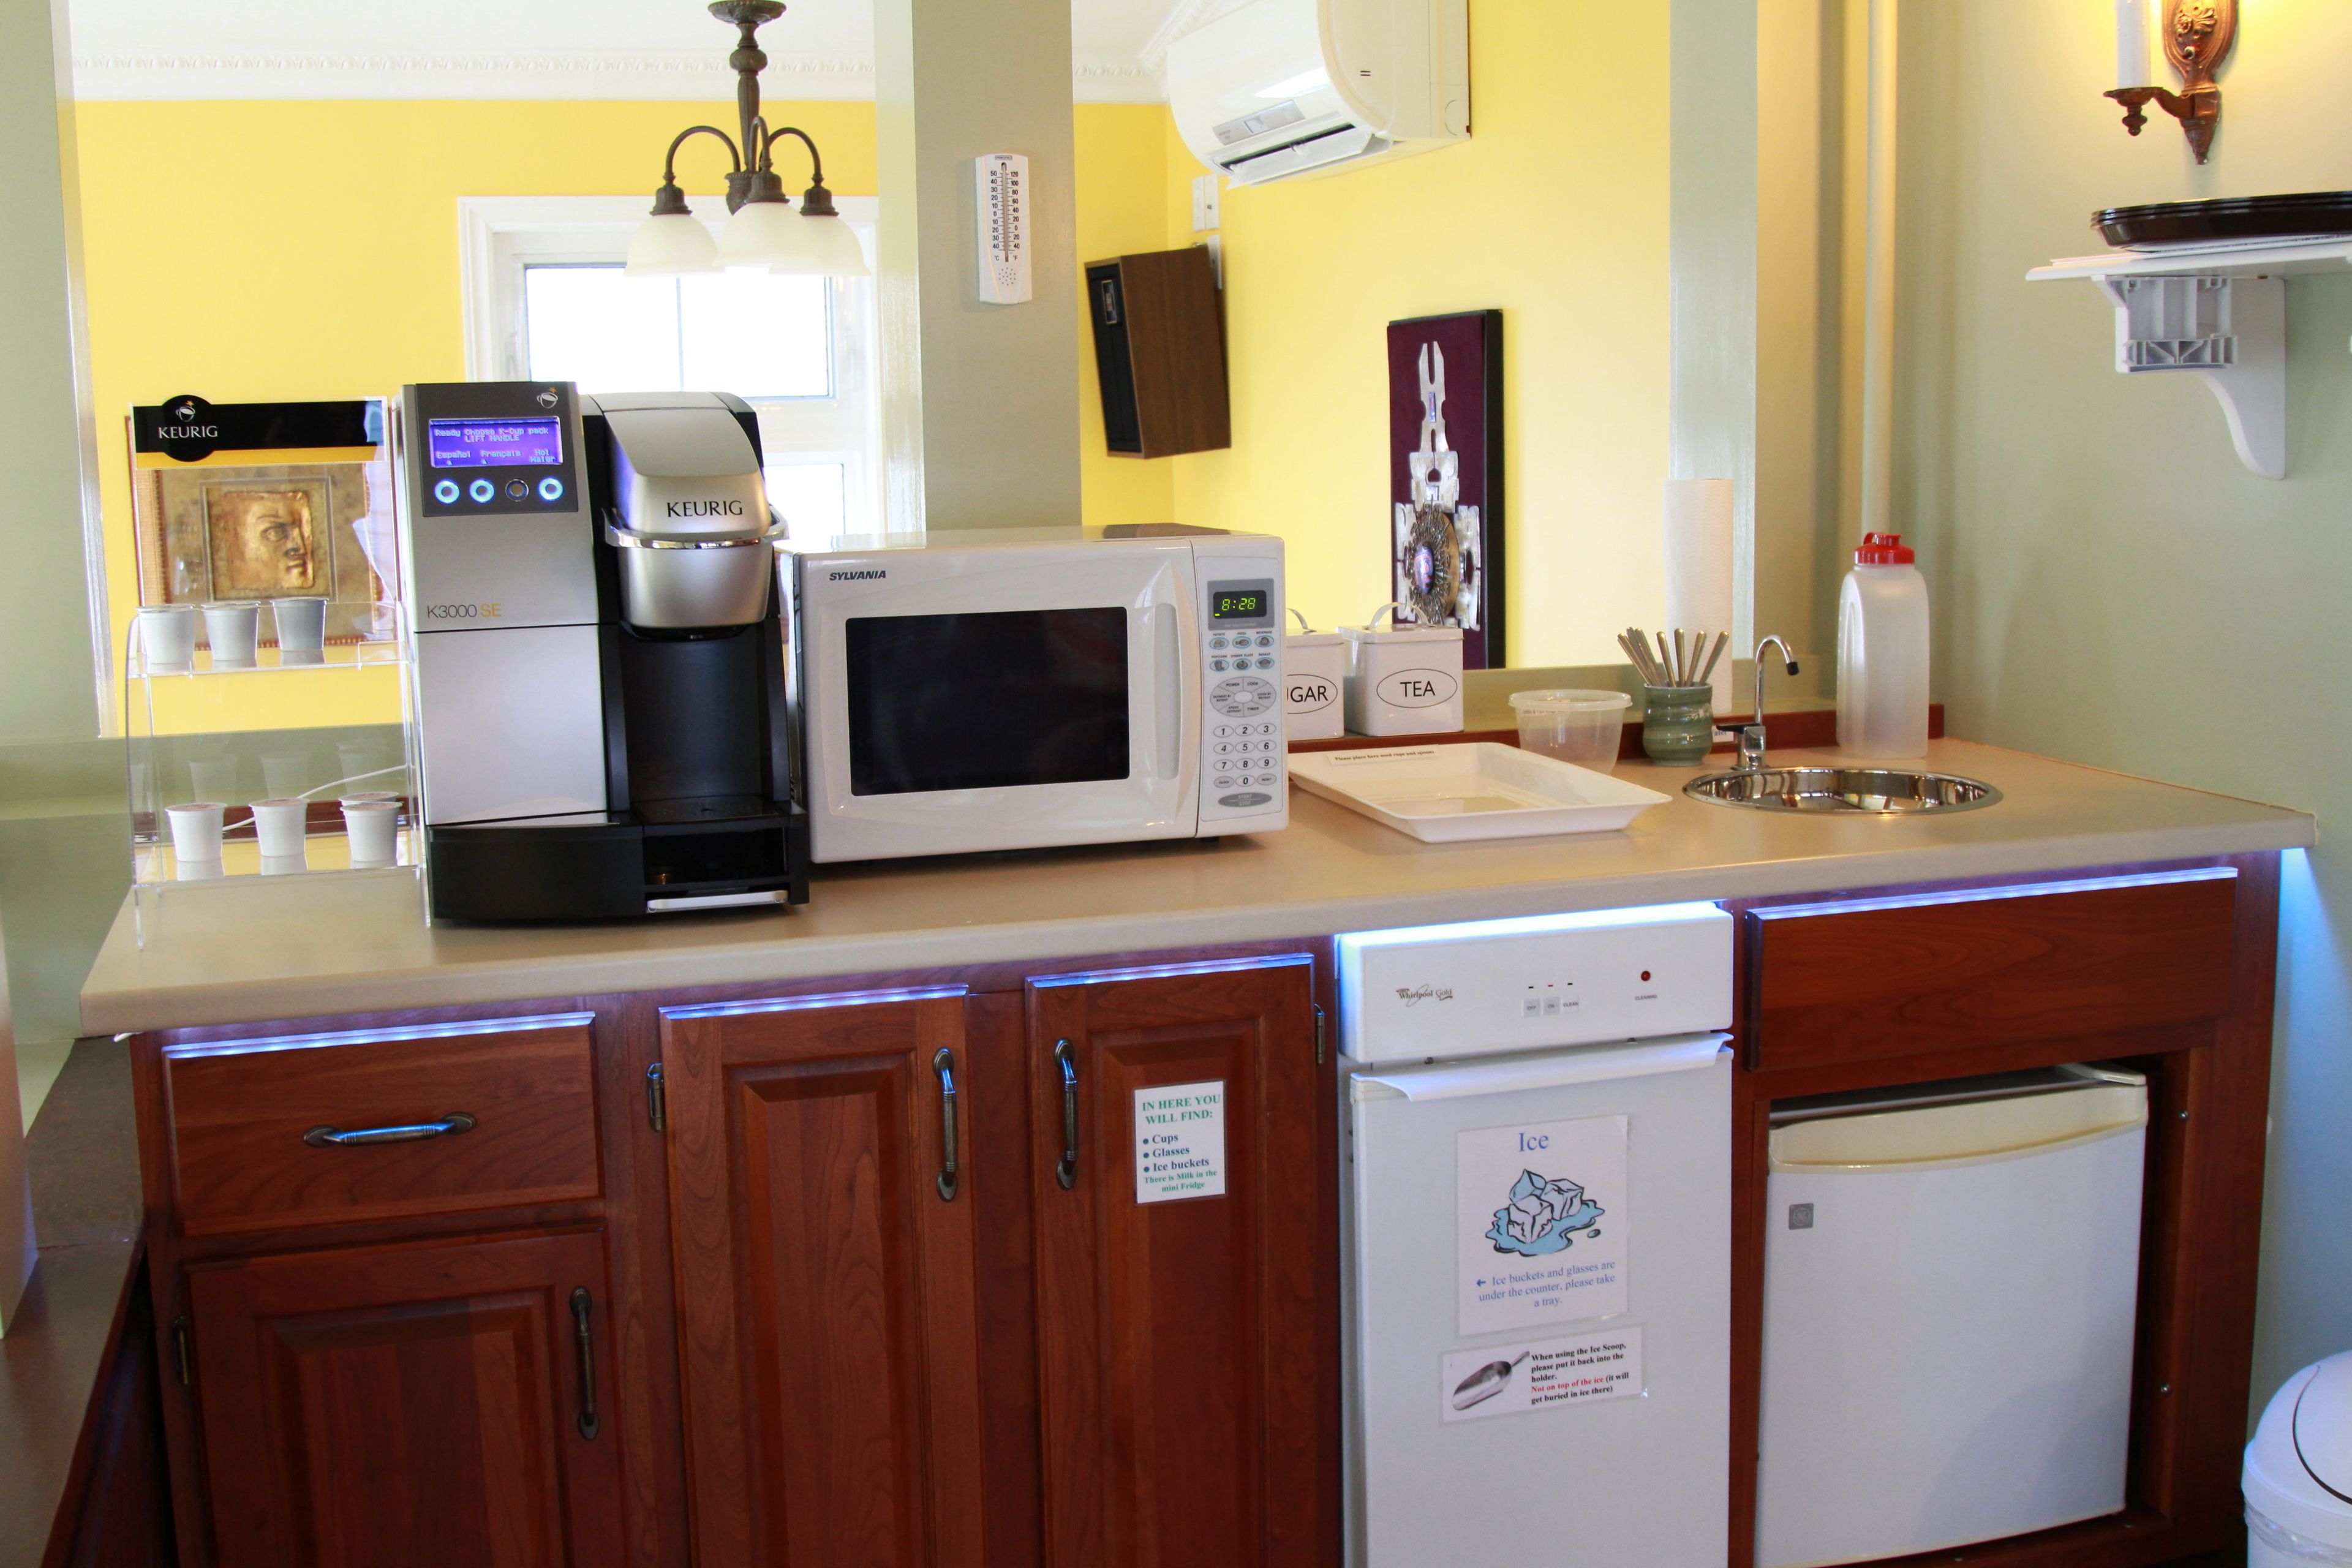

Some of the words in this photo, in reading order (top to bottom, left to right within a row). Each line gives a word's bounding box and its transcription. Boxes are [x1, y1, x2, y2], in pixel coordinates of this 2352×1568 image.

[159, 426, 218, 439] KEURIG
[667, 500, 743, 517] KEURIG
[829, 570, 886, 581] SYLVANIA
[428, 604, 477, 618] K3000
[480, 603, 501, 617] SE
[1221, 597, 1256, 611] 8:28
[1287, 685, 1329, 702] GAR
[1400, 680, 1435, 698] TEA
[1397, 990, 1433, 1000] Whirlpool
[1436, 989, 1452, 998] Gold
[1142, 1101, 1155, 1111] IN
[1159, 1098, 1191, 1110] HERE
[1195, 1094, 1221, 1105] YOU
[1145, 1114, 1178, 1124] WILL
[1181, 1109, 1213, 1121] FIND:
[1152, 1134, 1178, 1145] Cups
[1519, 1133, 1549, 1152] Ice
[1153, 1147, 1189, 1158] Glasses
[1153, 1163, 1168, 1172] Ice
[1171, 1158, 1209, 1170] buckets
[1181, 1181, 1205, 1189] Fridge
[1492, 1276, 1506, 1286] Ice
[1509, 1272, 1544, 1283] buckets
[1547, 1267, 1563, 1278] and
[1566, 1264, 1599, 1277] glasses
[1479, 1291, 1506, 1302] under
[1509, 1287, 1523, 1297] the
[1525, 1283, 1562, 1295] counter,
[1566, 1278, 1594, 1291] please
[1597, 1274, 1616, 1284] take
[1542, 1297, 1562, 1307] tray.
[1531, 1365, 1553, 1374] please
[1556, 1362, 1568, 1370] put
[1531, 1374, 1557, 1382] holder.
[1531, 1396, 1542, 1405] get
[1545, 1392, 1568, 1401] buried
[1591, 1385, 1613, 1394] there)
